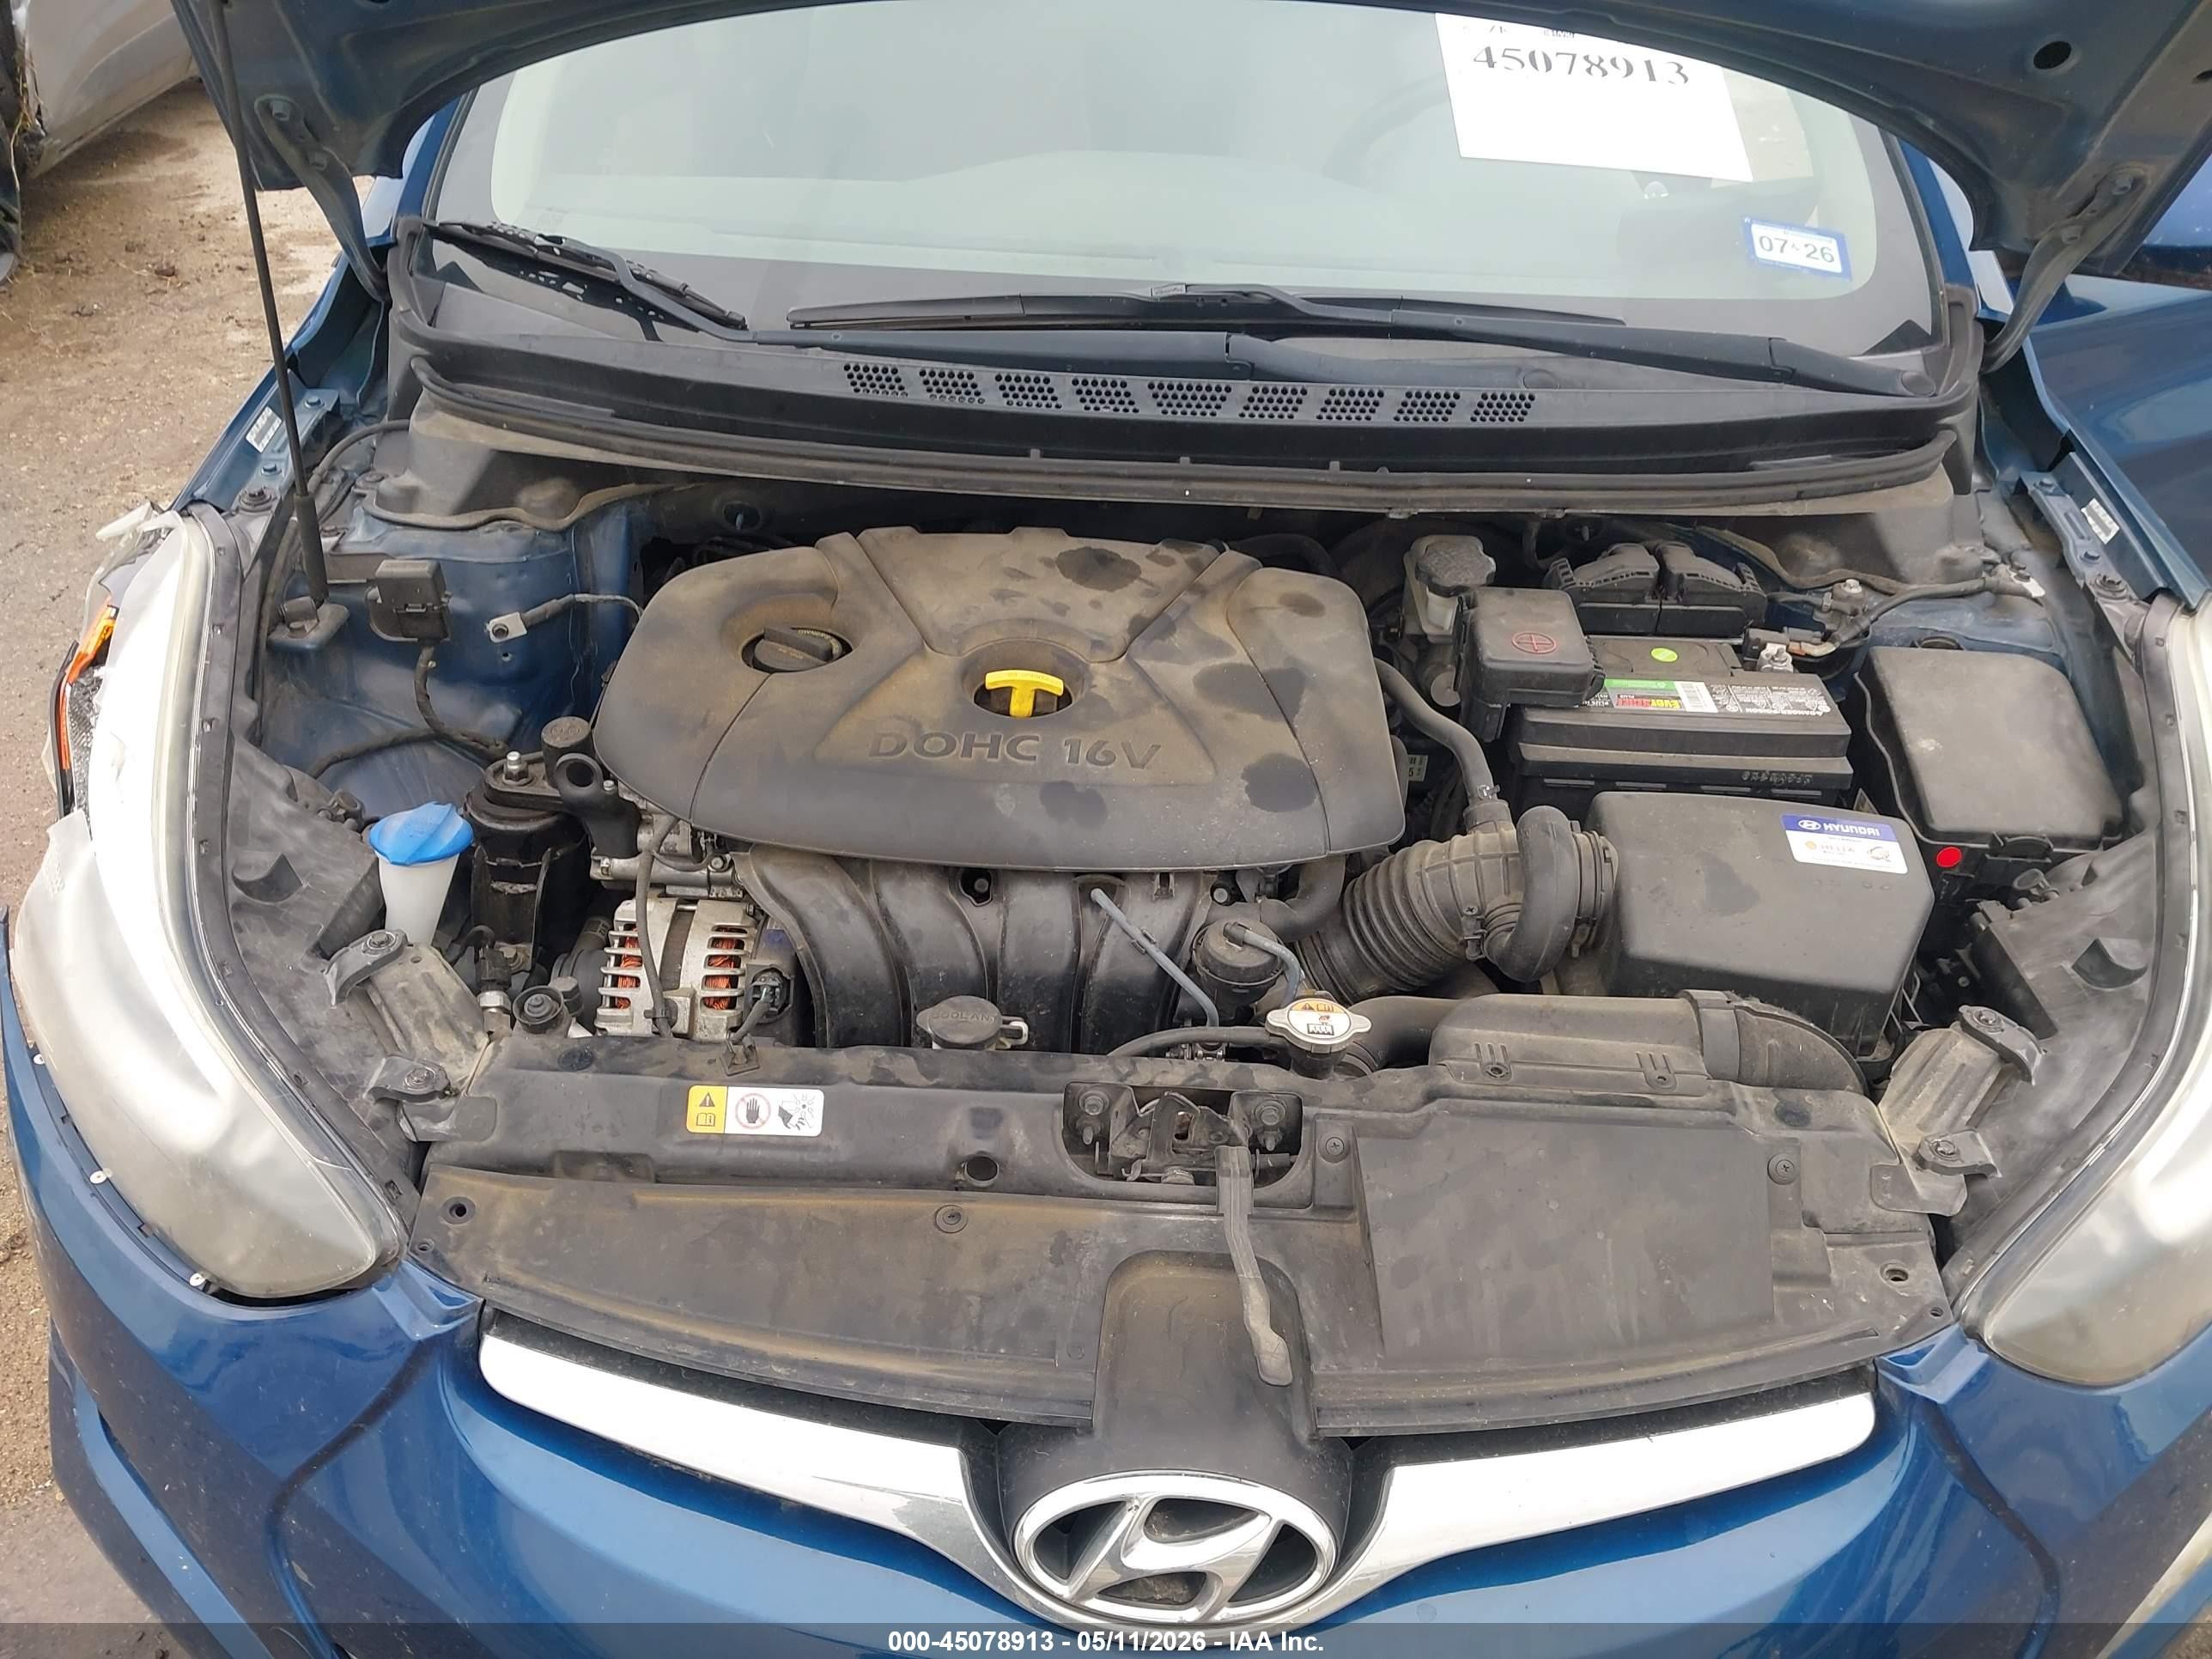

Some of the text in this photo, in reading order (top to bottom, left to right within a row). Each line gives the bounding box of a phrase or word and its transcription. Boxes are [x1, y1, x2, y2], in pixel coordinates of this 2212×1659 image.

[1473, 46, 1689, 84] 45078913
[1759, 235, 1835, 263] 07 26
[868, 732, 1161, 770] DOHC 16V
[1822, 822, 1881, 837] HYUNDAI
[932, 1009, 997, 1024] COOLANT
